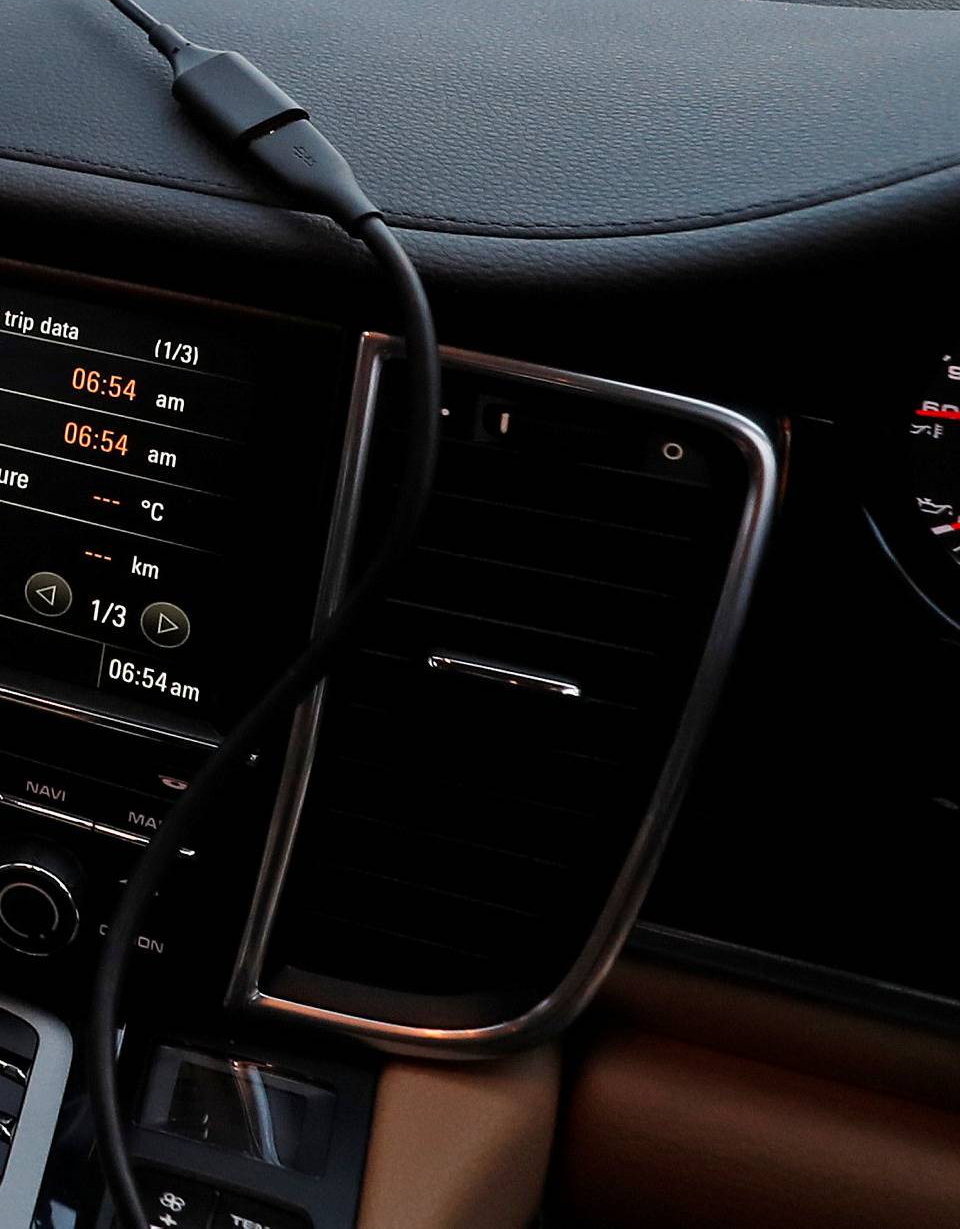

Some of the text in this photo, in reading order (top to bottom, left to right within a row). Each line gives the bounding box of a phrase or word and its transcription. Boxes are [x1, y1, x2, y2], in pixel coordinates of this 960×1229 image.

[4, 311, 34, 334] trip
[40, 317, 79, 341] data
[154, 340, 199, 365] (1/3)
[73, 368, 136, 401] 06:54
[155, 394, 185, 412] am
[65, 422, 127, 455] 06:54
[147, 450, 176, 468] am
[131, 555, 158, 580] km
[91, 599, 126, 628] 1/3
[26, 780, 66, 802] NAVI
[128, 811, 162, 830] MA
